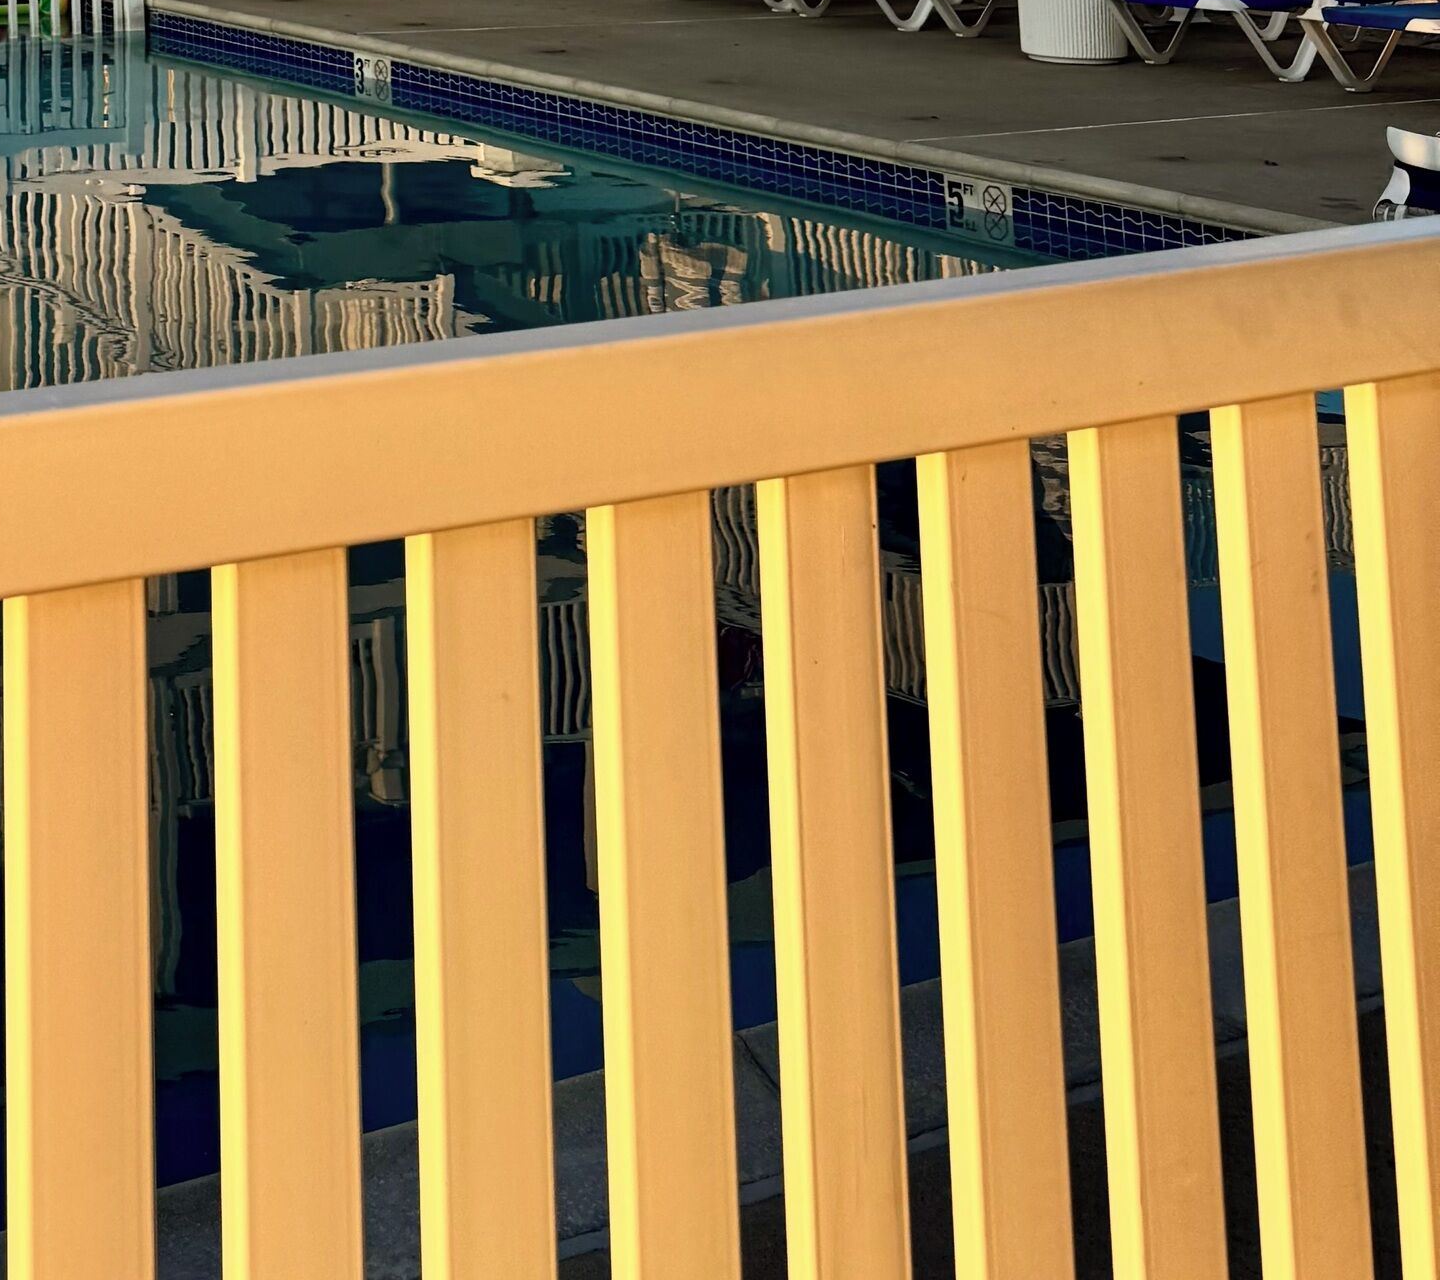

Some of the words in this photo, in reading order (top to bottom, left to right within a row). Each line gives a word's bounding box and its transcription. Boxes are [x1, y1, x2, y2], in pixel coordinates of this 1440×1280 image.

[355, 57, 364, 79] 3
[947, 180, 964, 207] 5
[963, 183, 974, 196] FT
